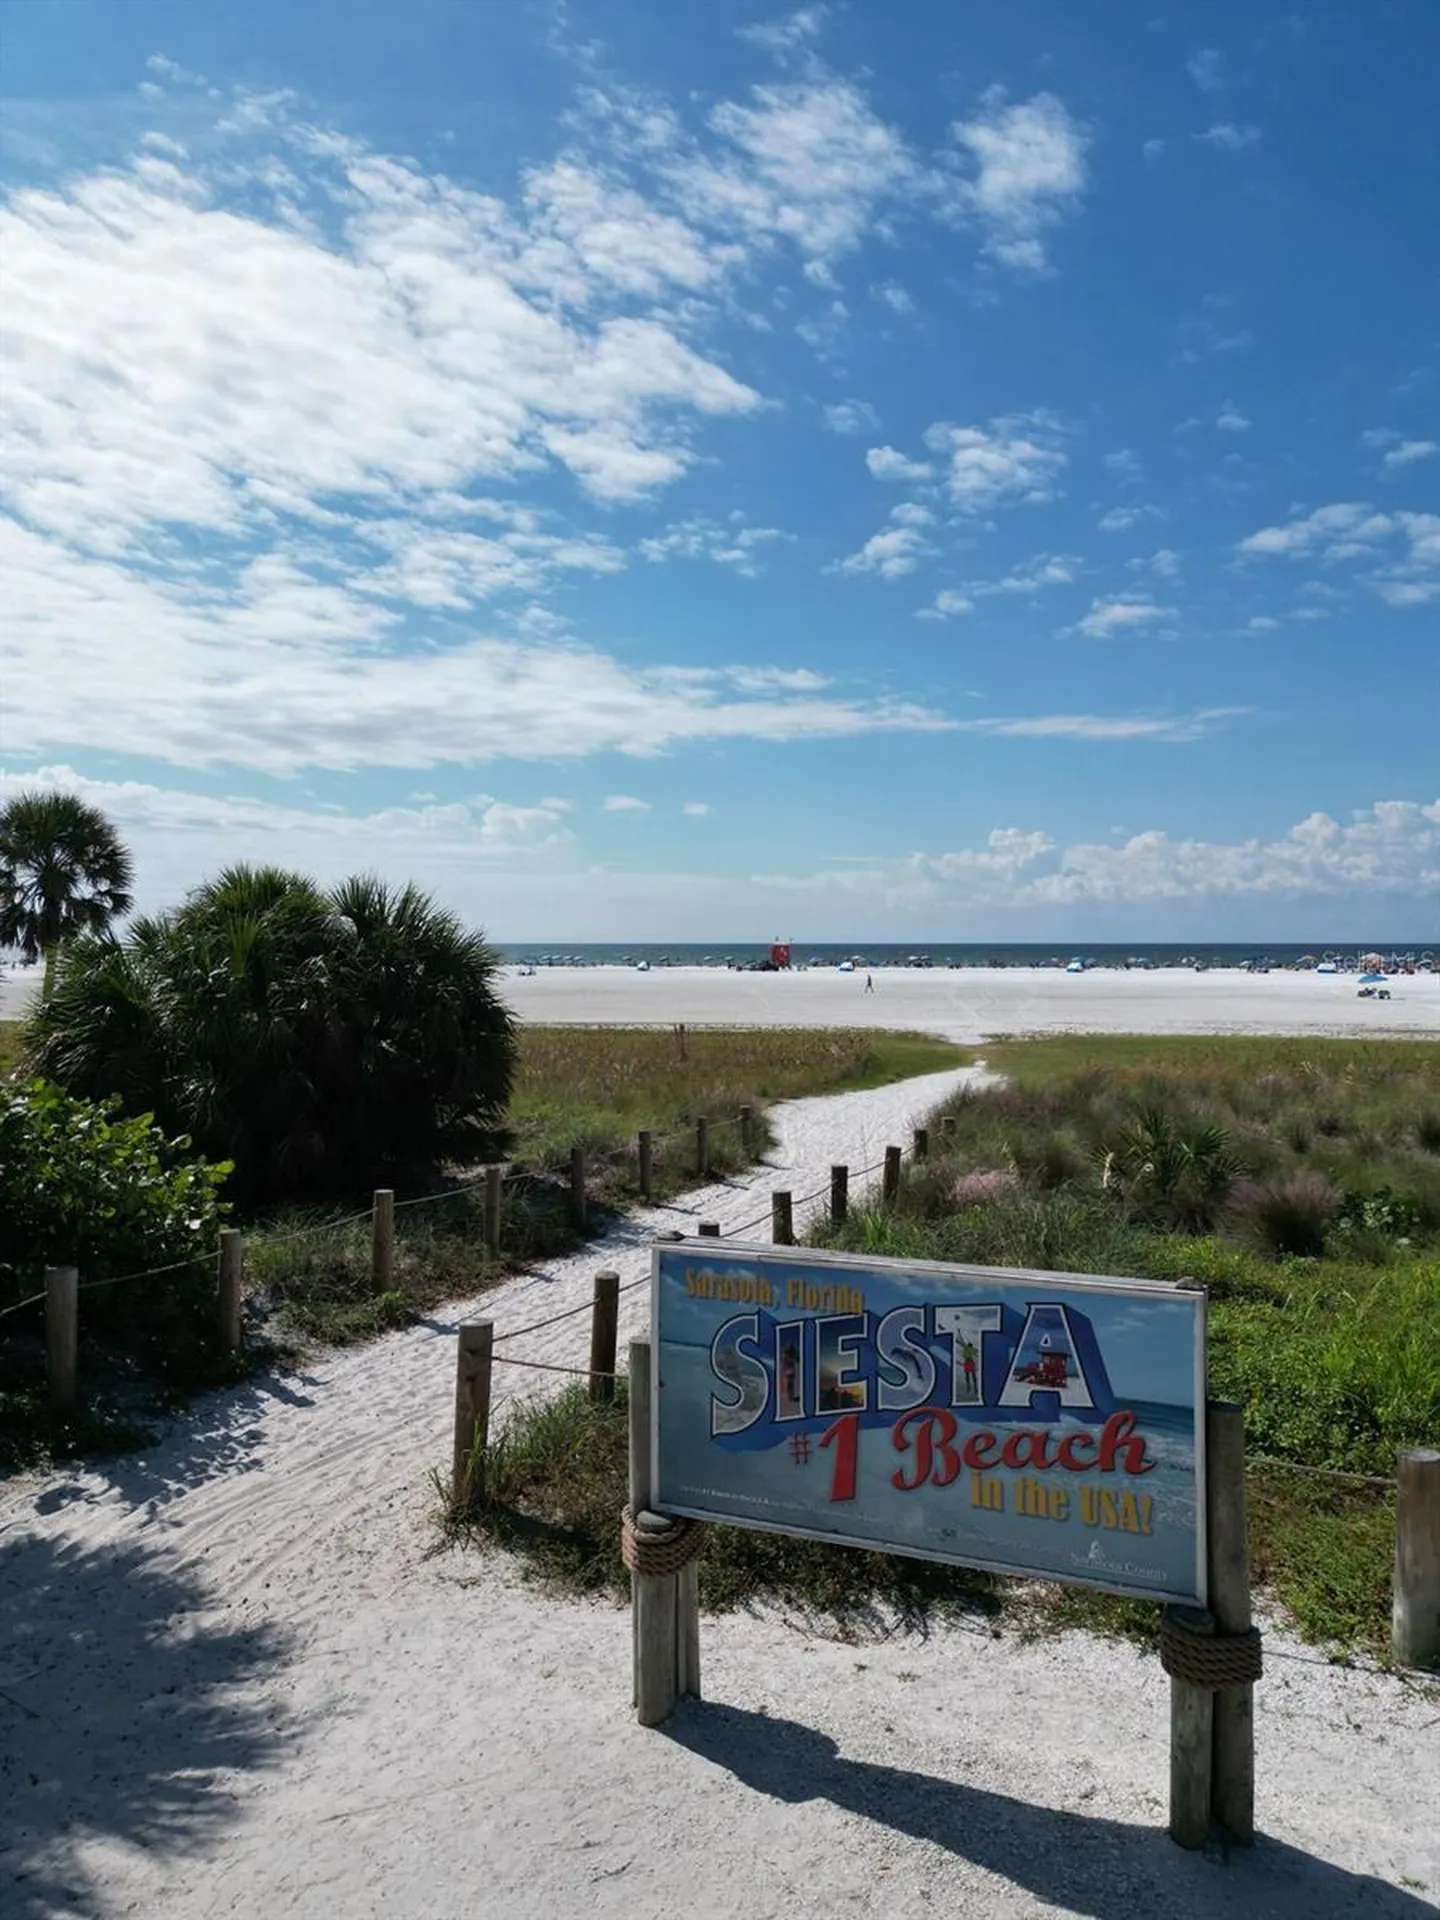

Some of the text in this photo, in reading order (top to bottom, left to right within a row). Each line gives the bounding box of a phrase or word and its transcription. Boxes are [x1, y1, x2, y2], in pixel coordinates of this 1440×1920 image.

[787, 1278, 865, 1314] Florida
[711, 1301, 1095, 1437] SIESTA
[788, 1407, 1158, 1502] #1 Beach
[970, 1471, 1153, 1536] in the USA!
